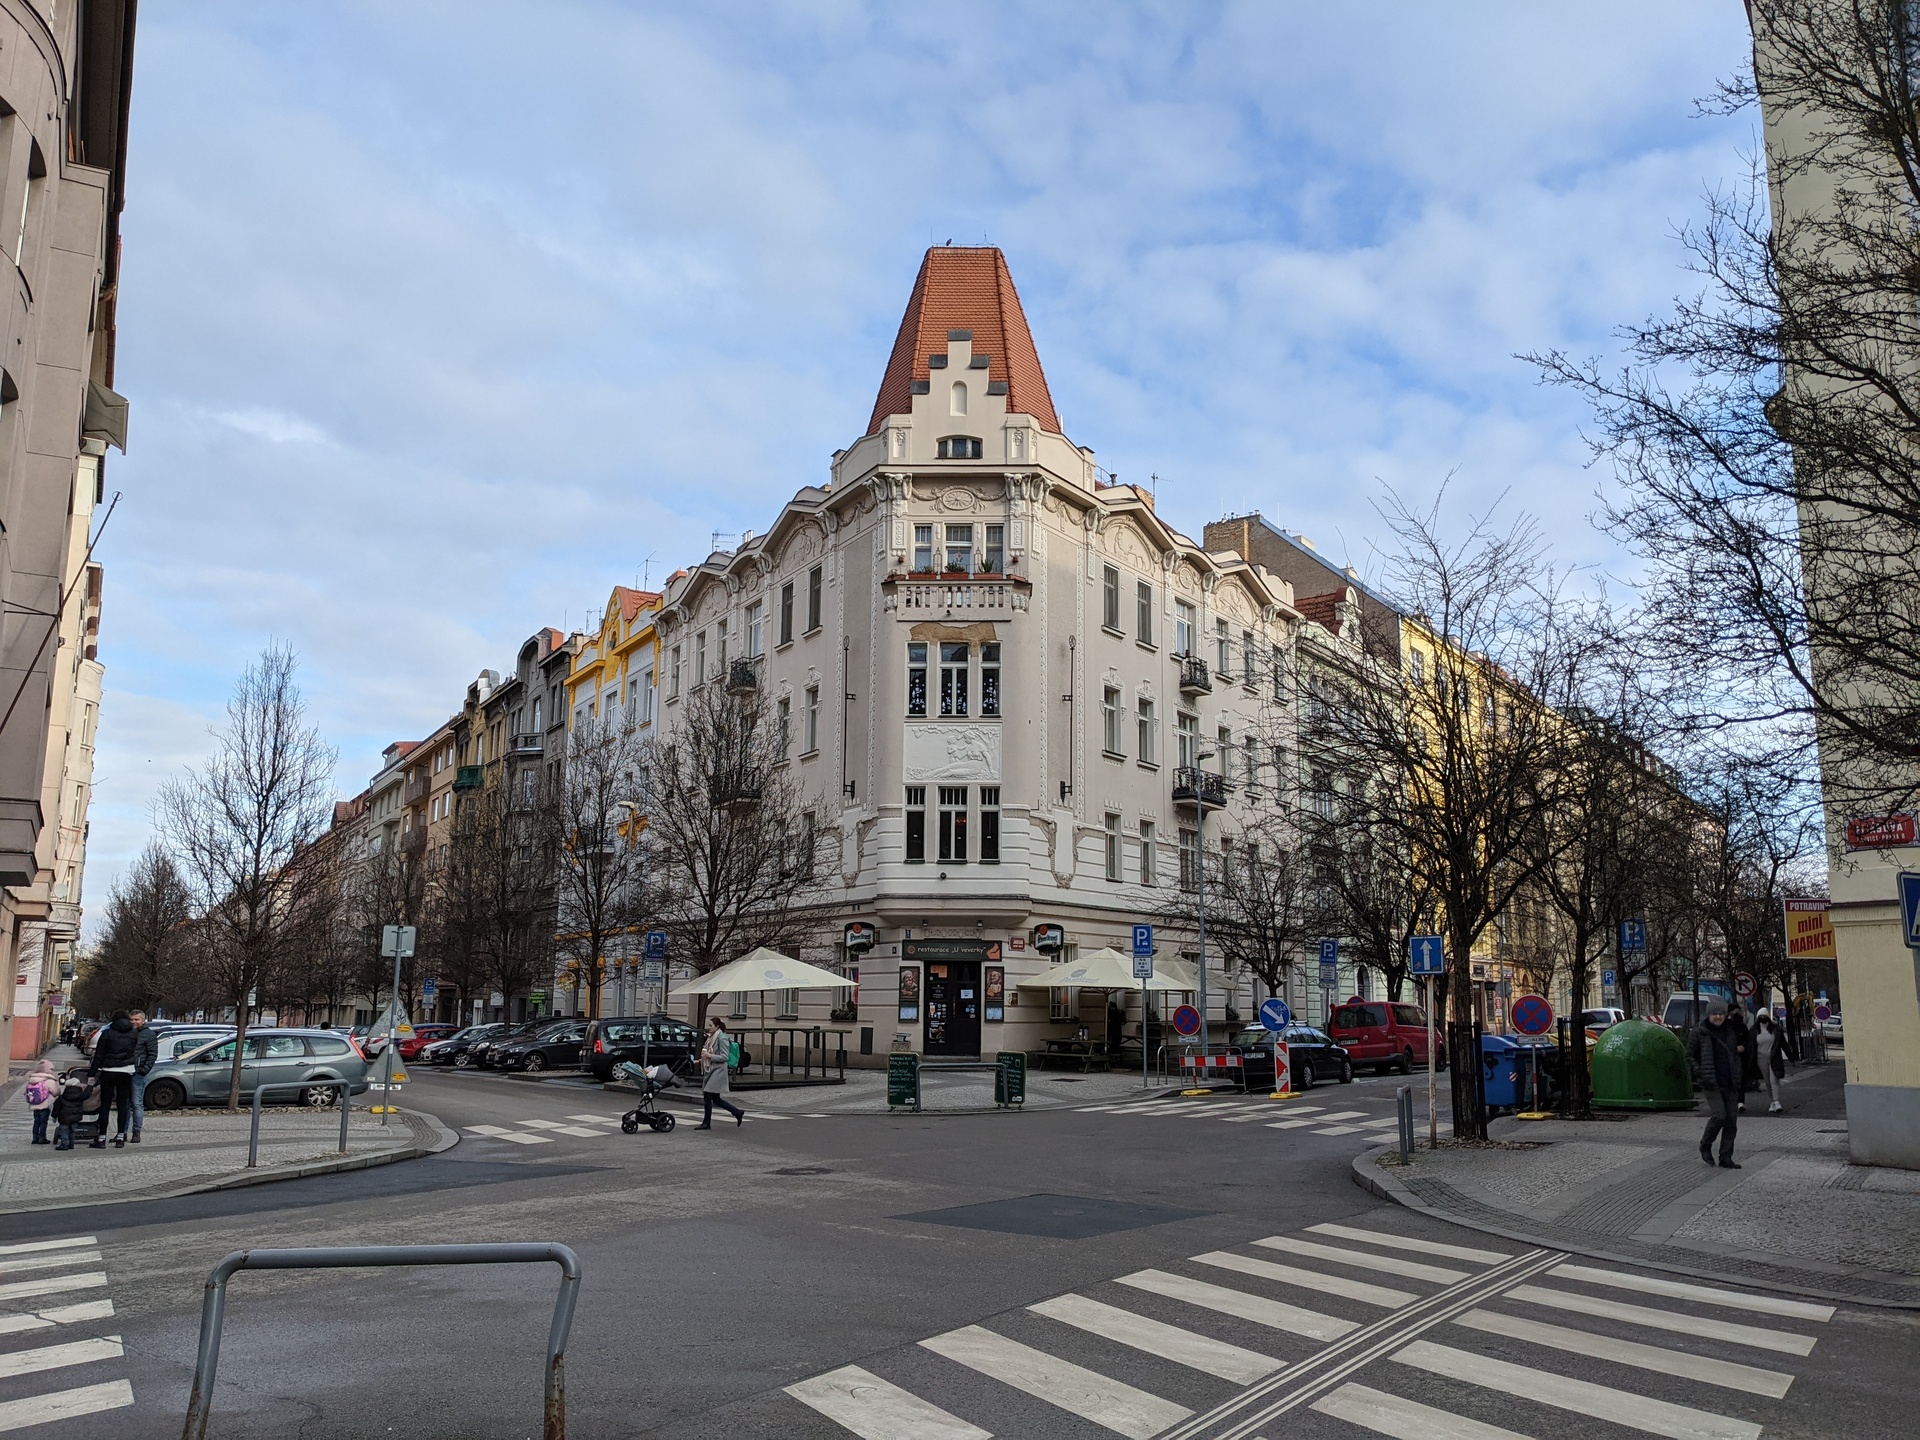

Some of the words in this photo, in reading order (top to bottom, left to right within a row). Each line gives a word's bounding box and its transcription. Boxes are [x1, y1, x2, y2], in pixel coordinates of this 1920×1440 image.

[1797, 913, 1823, 934] mini
[1136, 928, 1148, 946] P
[1790, 930, 1832, 954] MARKET
[1323, 942, 1334, 957] P
[1605, 971, 1612, 981] P
